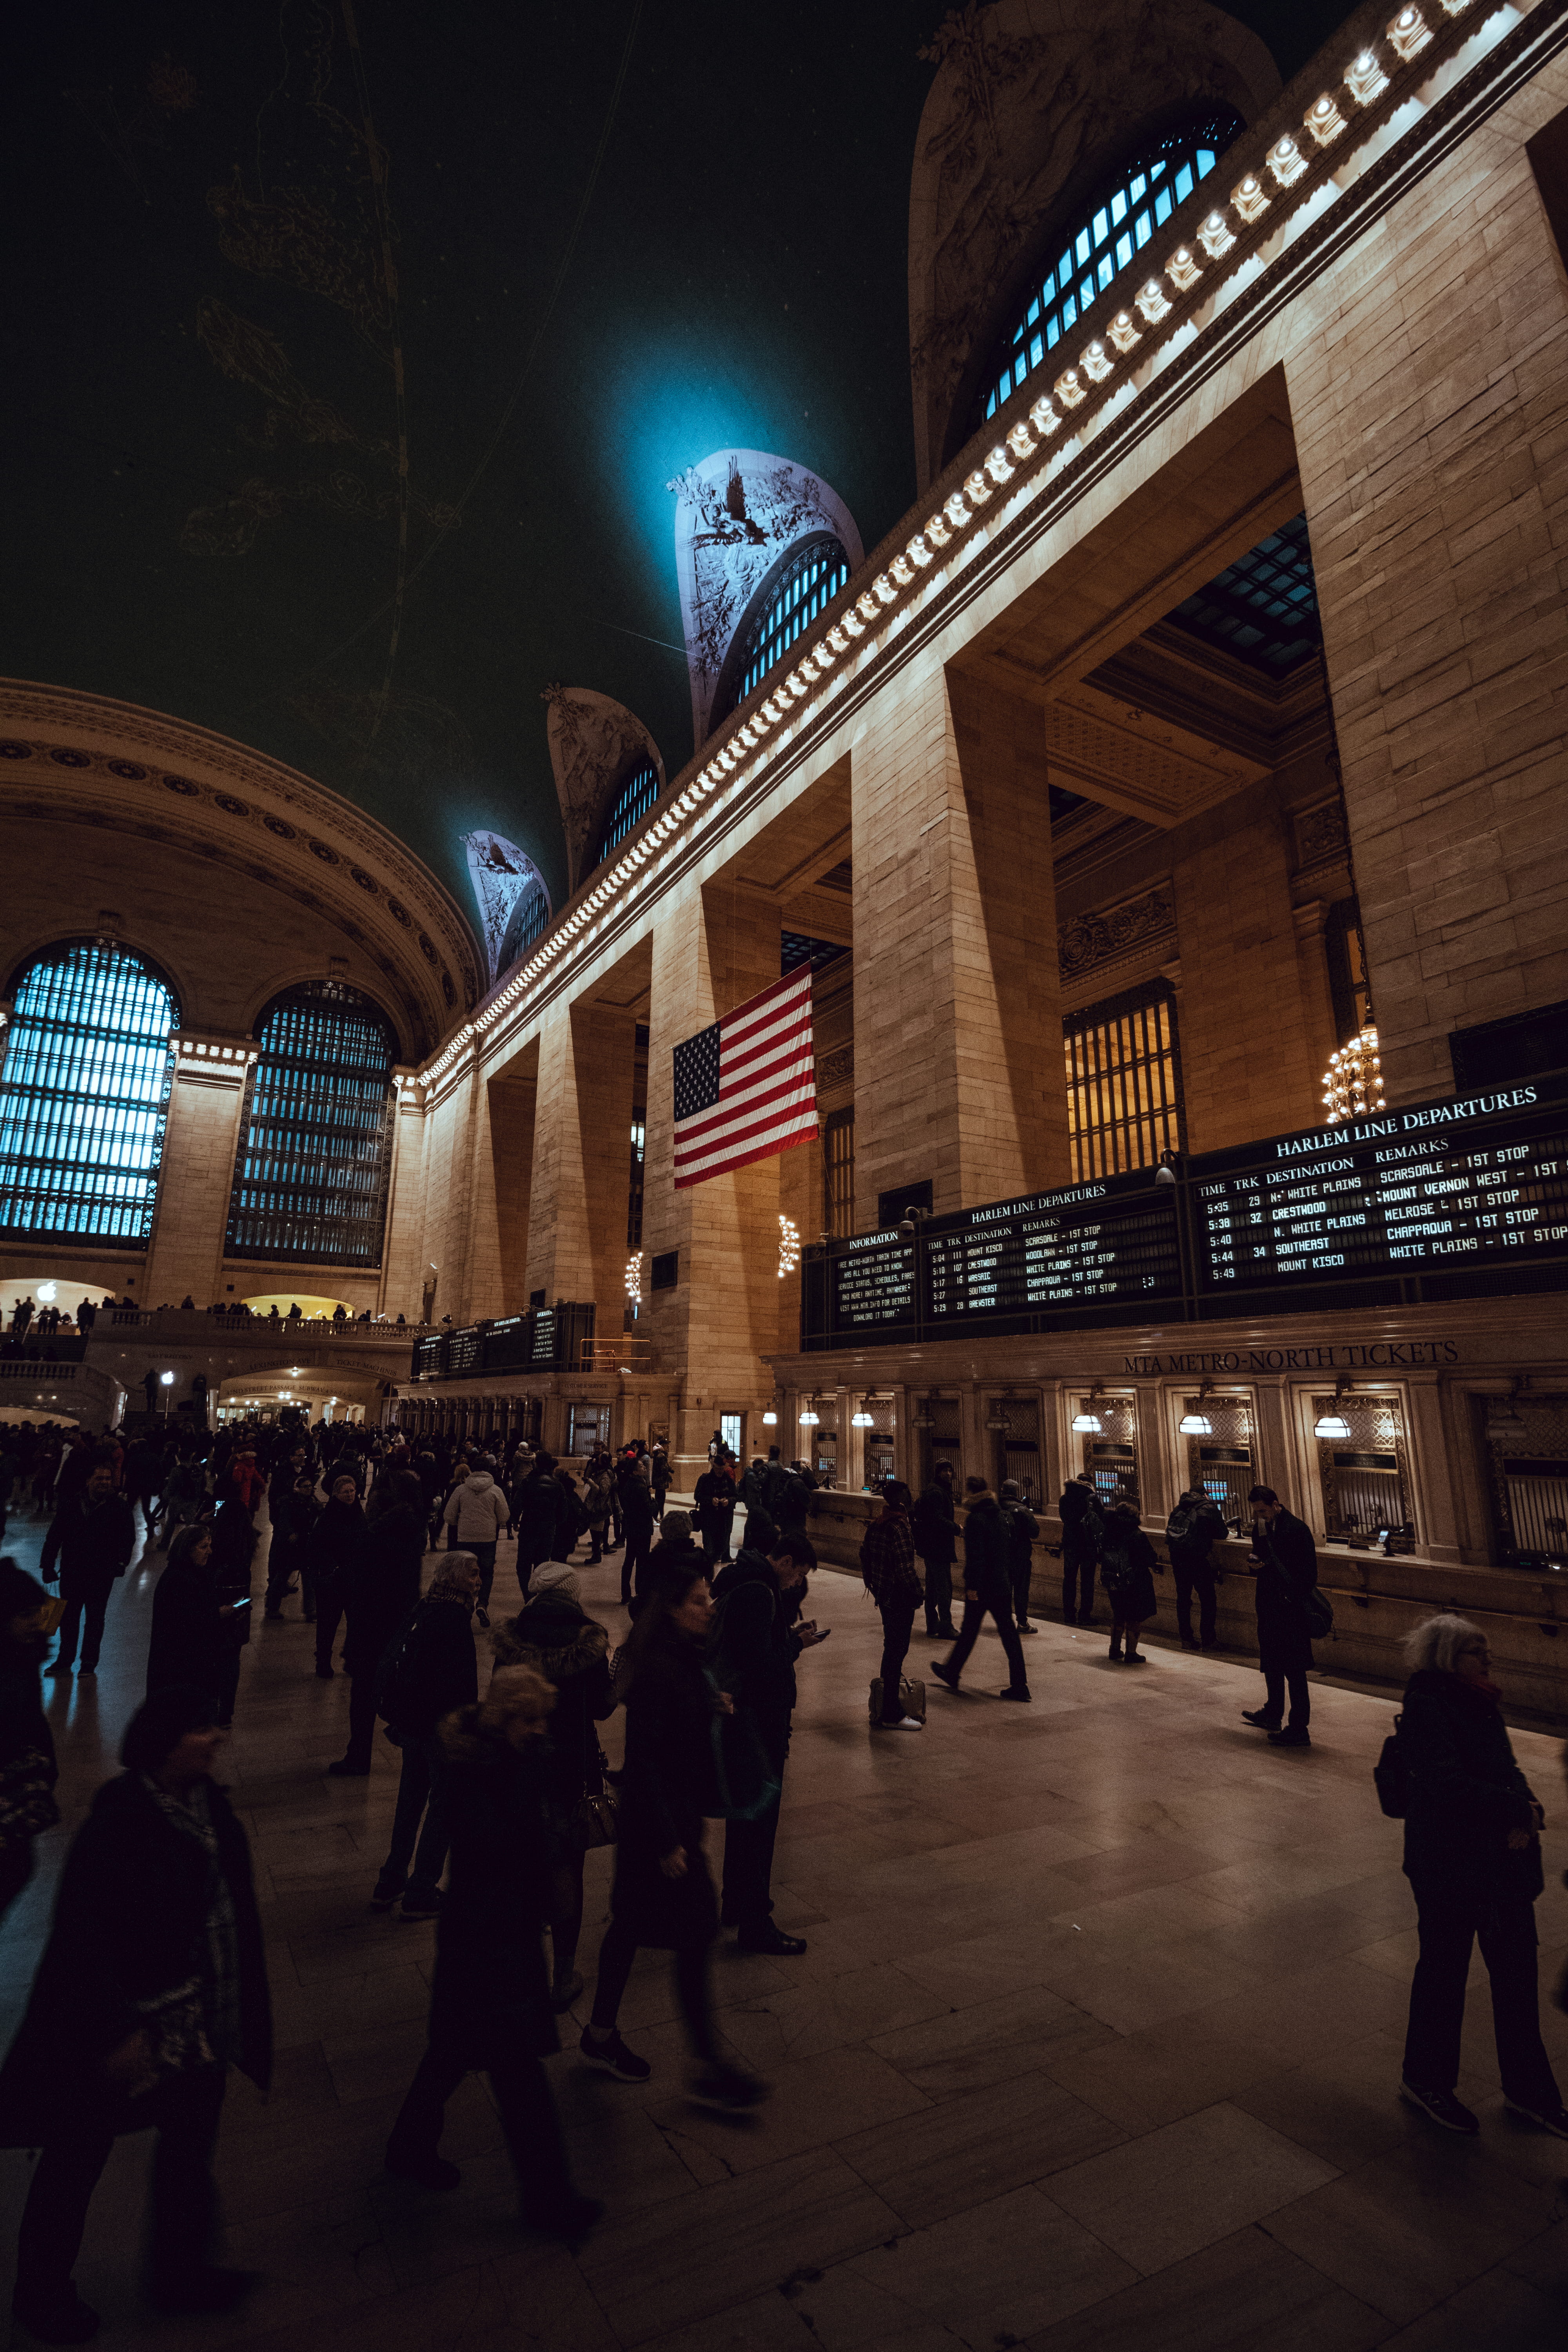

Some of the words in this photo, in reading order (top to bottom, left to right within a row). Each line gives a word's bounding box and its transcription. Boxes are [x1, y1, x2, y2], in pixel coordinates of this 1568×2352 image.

[1277, 1129, 1350, 1158] HARLEM
[1354, 1118, 1398, 1141] LINE
[1403, 1086, 1537, 1131] DEPARTURES
[1198, 1183, 1226, 1196] TIME
[1234, 1177, 1259, 1190] TRK
[1267, 1157, 1354, 1183] DESTINATION
[1375, 1138, 1449, 1163] REMARKS
[1207, 1201, 1228, 1214] 5:35
[1249, 1196, 1260, 1206] 29
[1288, 1185, 1318, 1199] WHITE
[1323, 1177, 1361, 1193] PLAINS
[1381, 1161, 1444, 1183] SCARSDALE
[1467, 1153, 1488, 1167] 1ST
[1497, 1145, 1529, 1162] STOP
[973, 1205, 1011, 1223] HARLEM
[1013, 1200, 1035, 1214] LINE
[1039, 1184, 1105, 1209] DEPARTURES
[1209, 1218, 1230, 1230] 5:38
[1250, 1212, 1262, 1223] 32
[1272, 1201, 1326, 1220] CRESTWOOD
[1383, 1186, 1417, 1202] MOUNT
[1424, 1177, 1469, 1195] VERNON
[1476, 1171, 1507, 1187] WEST
[1534, 1161, 1557, 1177] 1ST
[927, 1241, 942, 1250] TIME
[947, 1237, 961, 1246] TRK
[965, 1227, 1012, 1243] DESTINATION
[1023, 1217, 1060, 1231] REMARKS
[1210, 1235, 1232, 1246] 5:40
[1274, 1227, 1285, 1237] N.
[1291, 1221, 1321, 1234] WHITE
[1327, 1214, 1366, 1229] PLAINS
[1385, 1203, 1435, 1221] MELROSE
[1457, 1196, 1478, 1210] 1ST
[1487, 1189, 1519, 1205] STOP
[850, 1231, 898, 1249] INFORMATION
[933, 1254, 944, 1263] 5:04
[967, 1247, 983, 1257] MOUNT
[986, 1243, 1002, 1253] KISCO
[1025, 1233, 1058, 1246] SCARSDALE
[1069, 1229, 1080, 1239] 1ST
[1085, 1225, 1100, 1236] STOP
[1212, 1251, 1233, 1263] 5:44
[1253, 1247, 1265, 1257] 34
[1276, 1238, 1329, 1254] SOUTHEAST
[1387, 1220, 1452, 1240] CHAPPAQUA
[1475, 1214, 1497, 1228] 1ST
[1506, 1208, 1539, 1224] STOP
[849, 1256, 874, 1267] METRO-NORTH
[877, 1253, 889, 1261] TRAIN
[891, 1262, 904, 1270] KNOW.
[933, 1267, 945, 1275] 5:10
[968, 1258, 996, 1269] CRESTWOOD
[1026, 1248, 1055, 1260] WOODLAWN
[1067, 1244, 1078, 1254] 1ST
[1082, 1241, 1097, 1251] STOP
[1213, 1268, 1235, 1279] 5:49
[1278, 1259, 1307, 1272] MOUNT
[1312, 1254, 1344, 1268] KISCO
[1390, 1244, 1426, 1259] WHITE
[1432, 1238, 1477, 1254] PLAINS
[1503, 1231, 1525, 1245] 1ST
[1534, 1226, 1568, 1241] STOP
[875, 1274, 899, 1284] SCHEDULES,
[933, 1279, 945, 1287] 5:17
[968, 1272, 990, 1282] WASSAIC
[1027, 1264, 1045, 1274] WHITE
[1048, 1260, 1071, 1270] PLAINS
[1083, 1256, 1094, 1265] 1ST
[1098, 1253, 1114, 1263] STOP
[934, 1291, 945, 1299] 5:27
[969, 1284, 997, 1295] SOUTHEAST
[1027, 1275, 1060, 1287] CHAPPAQUA
[1072, 1272, 1083, 1281] 1ST
[1087, 1269, 1103, 1279] STOP
[851, 1300, 880, 1309] WWW.MTA.INFO
[891, 1296, 910, 1305] DETAILS
[865, 1289, 884, 1297] ANYTIME,
[969, 1298, 995, 1308] BREWSTER
[1028, 1292, 1046, 1301] WHITE
[1049, 1289, 1073, 1299] PLAINS
[1085, 1285, 1096, 1294] 1ST
[1100, 1283, 1117, 1292] STOP
[853, 1313, 872, 1321] DOWNLOAD
[249, 1359, 294, 1370] LEXINGTON
[363, 1363, 397, 1376] MACHINES
[1124, 1356, 1163, 1373] MTA
[1169, 1347, 1336, 1372] METRO-NORTH
[1342, 1340, 1459, 1365] TICKETS
